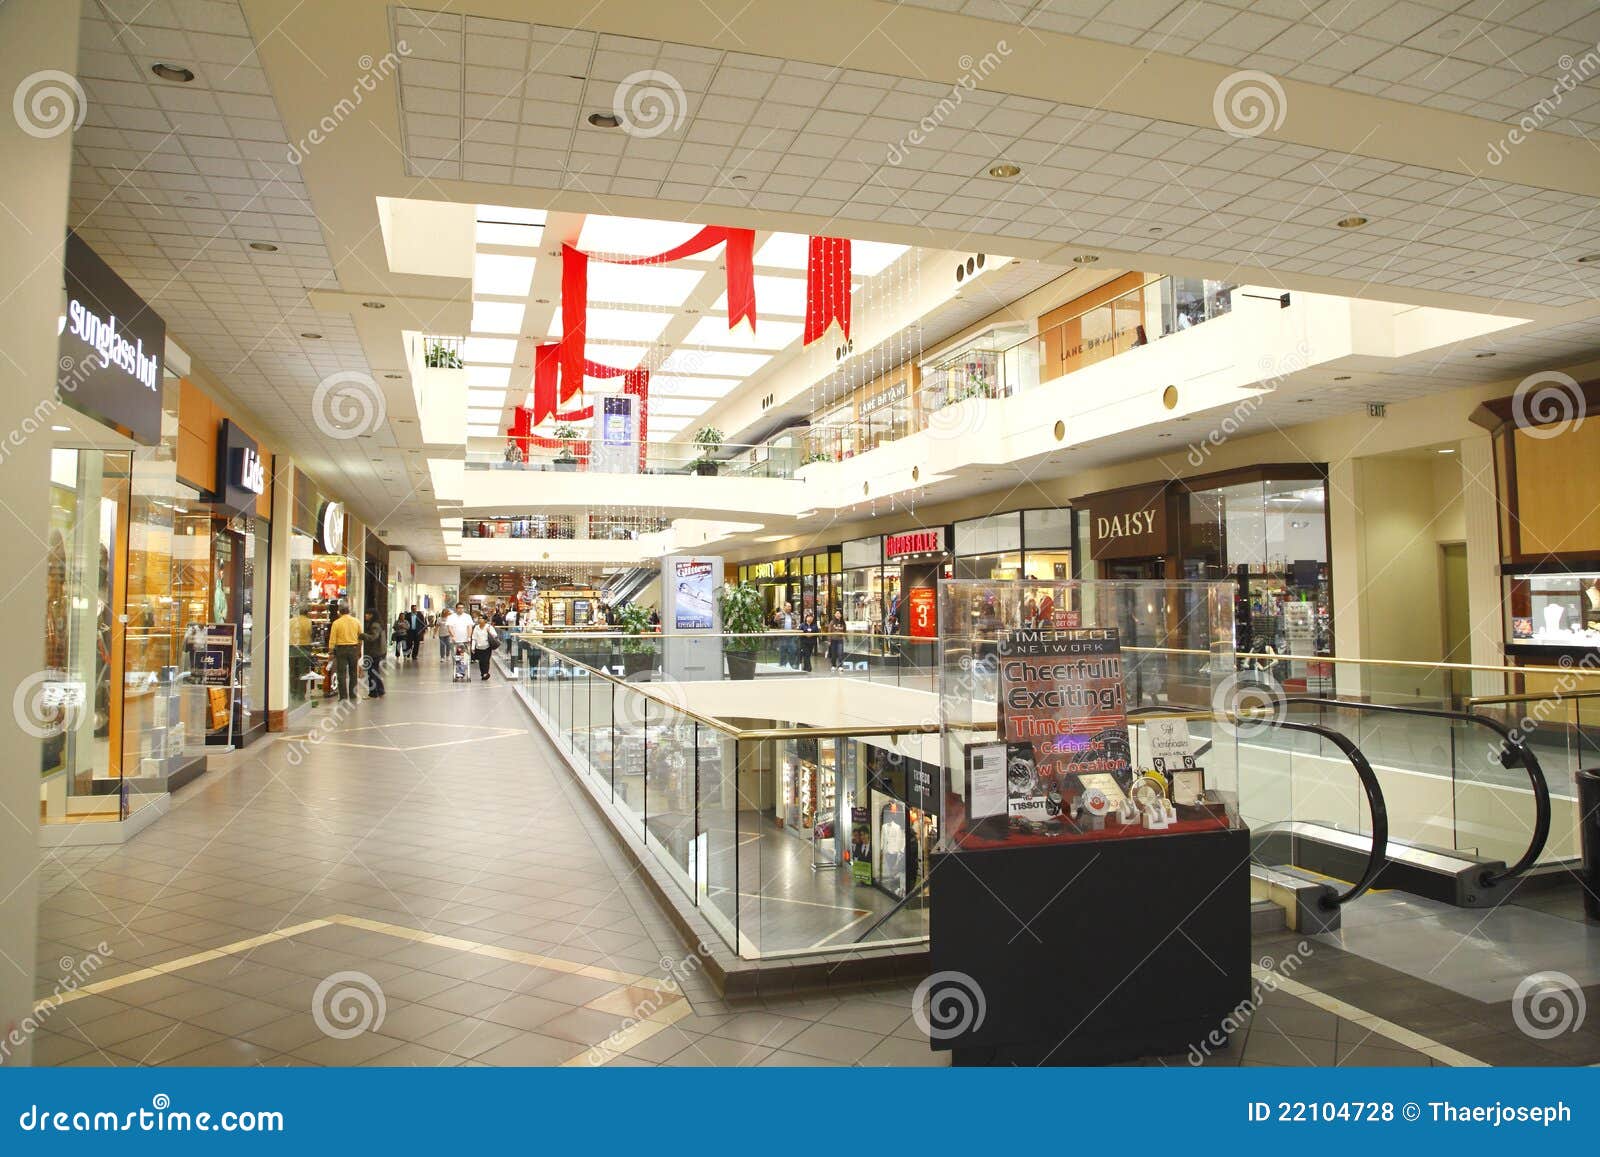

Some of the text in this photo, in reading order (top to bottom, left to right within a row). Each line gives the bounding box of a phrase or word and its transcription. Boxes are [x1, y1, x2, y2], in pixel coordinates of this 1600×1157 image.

[69, 299, 157, 391] sunglass hut
[1370, 404, 1385, 417] EXIT
[242, 447, 264, 496] Lids
[1097, 509, 1157, 540] DAISY
[917, 604, 928, 627] 3
[1001, 629, 1117, 642] TIMEPIECE
[1017, 643, 1104, 654] NETWORK
[1003, 657, 1121, 683] Cheerfull!
[1008, 682, 1123, 711] Exciting!
[1040, 738, 1105, 755] Celebrate
[1056, 757, 1127, 776] Location
[1011, 801, 1045, 811] TISSOT
